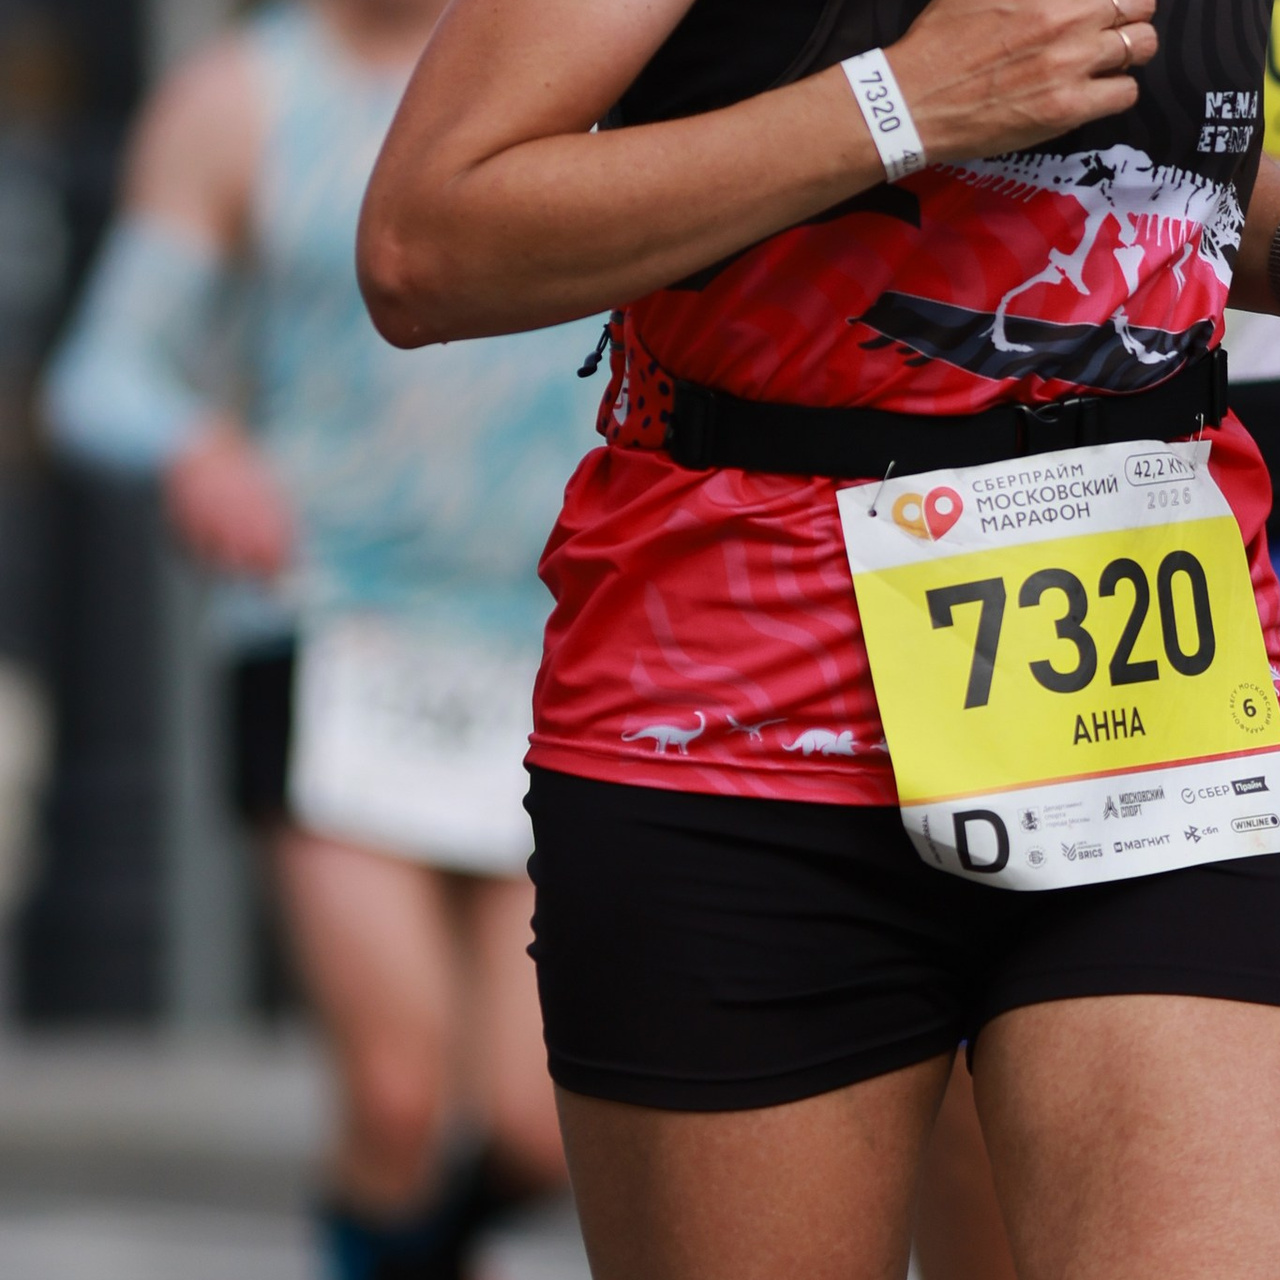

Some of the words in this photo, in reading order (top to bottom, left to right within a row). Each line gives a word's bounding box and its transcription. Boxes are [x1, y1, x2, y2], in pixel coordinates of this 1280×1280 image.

[860, 70, 901, 132] 7320
[972, 463, 1084, 493] СБЕРПРАЙМ
[1134, 459, 1165, 480] 42,2
[976, 474, 1119, 513] МОСКОВСКИЙ
[981, 501, 1091, 533] МАРАФОН
[925, 550, 1216, 710] 7320
[1243, 698, 1257, 718] 6
[1072, 706, 1146, 746] АННА
[1119, 785, 1165, 804] МОСКОВСКИЙ
[1198, 785, 1230, 799] СБЕР
[1235, 780, 1263, 792] Прайм
[1121, 804, 1143, 818] СПОРТ
[1235, 817, 1270, 830] WINLINE
[952, 809, 1010, 874] D
[1124, 833, 1171, 851] магнит
[1078, 848, 1103, 860] BRICS
